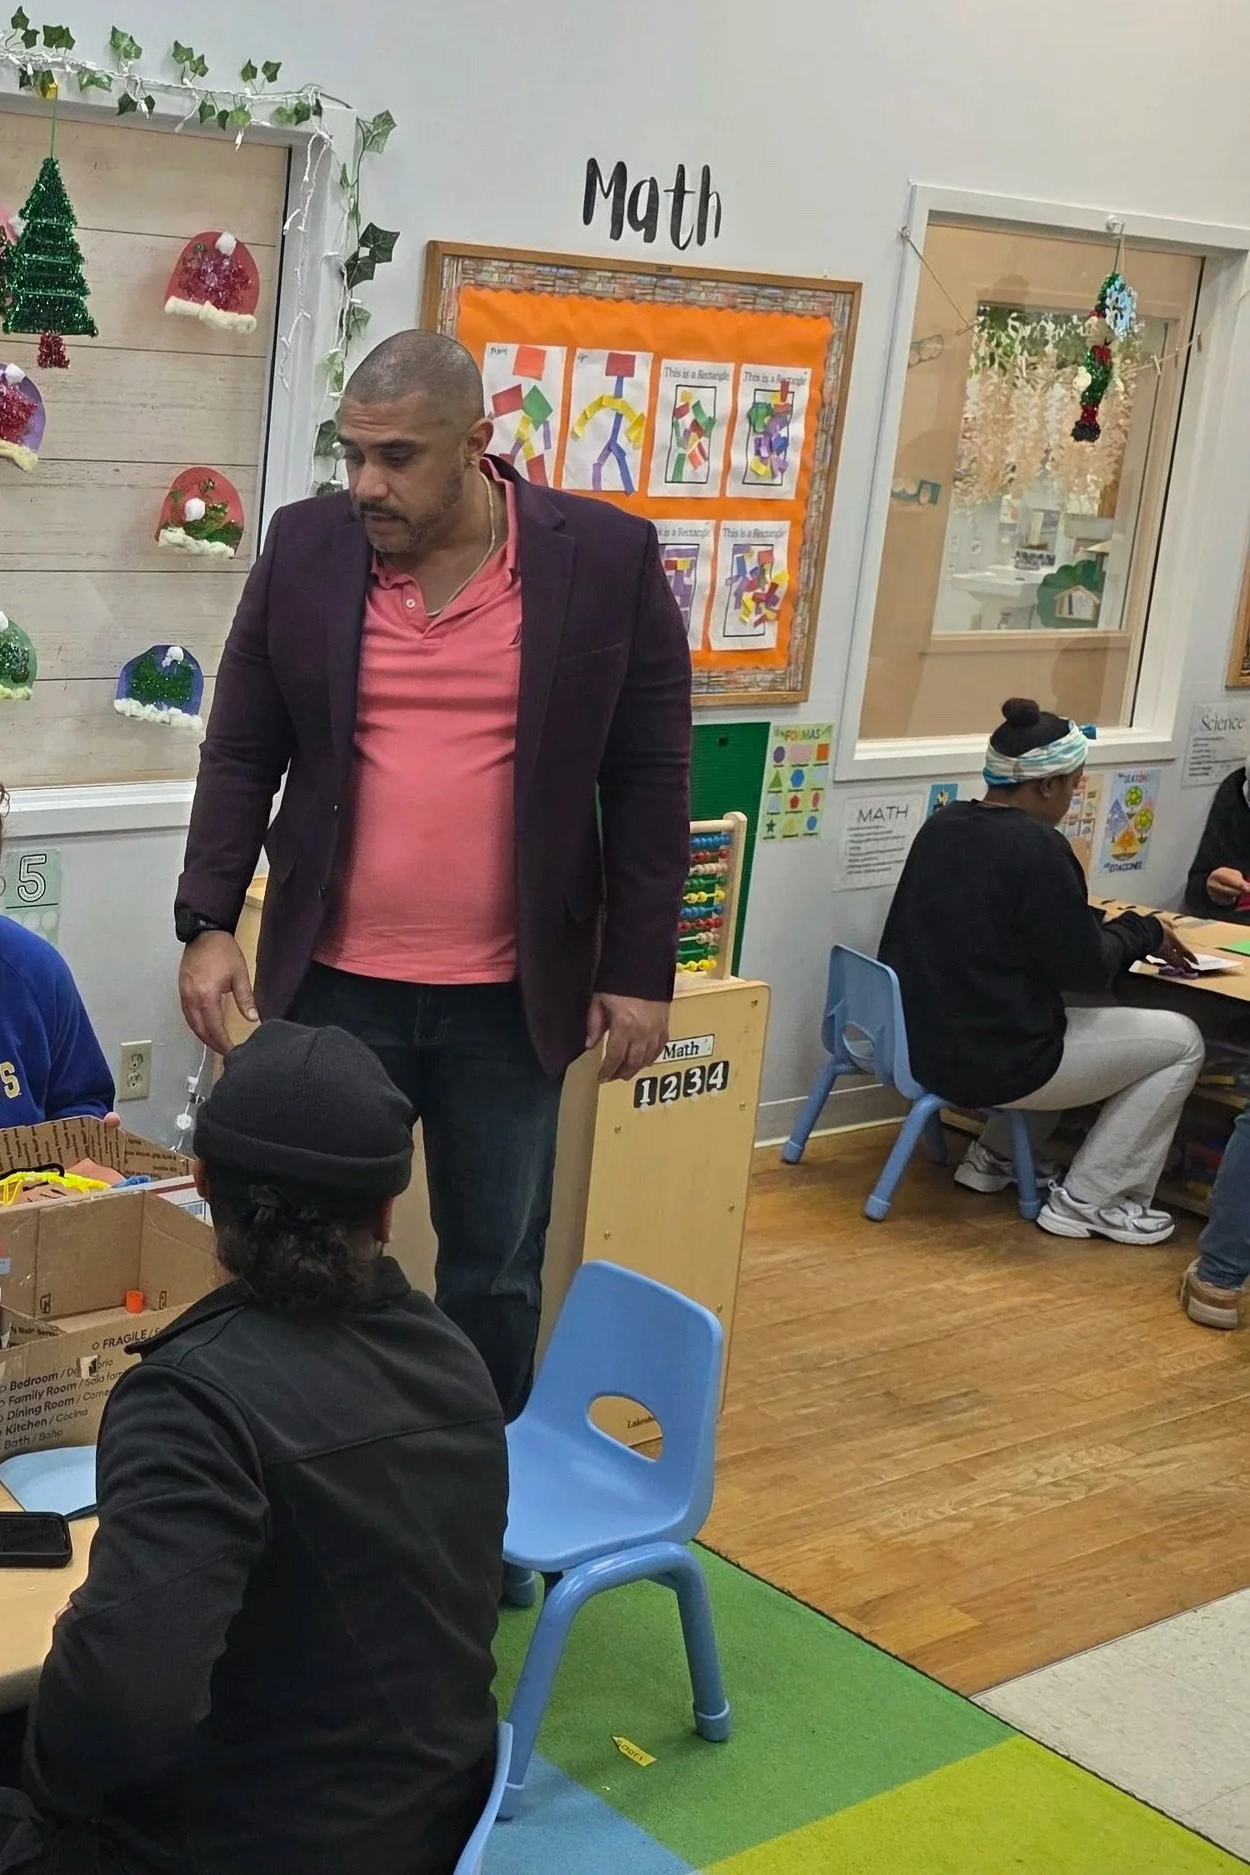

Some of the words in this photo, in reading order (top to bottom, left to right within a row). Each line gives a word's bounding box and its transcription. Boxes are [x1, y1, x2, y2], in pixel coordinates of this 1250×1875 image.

[583, 157, 722, 250] Math
[664, 367, 681, 379] This
[682, 368, 689, 379] is
[691, 371, 696, 379] a
[744, 371, 760, 382] This
[762, 373, 769, 383] is
[723, 527, 739, 538] This
[1199, 715, 1246, 732] Science
[857, 804, 909, 823] MATH
[17, 853, 48, 902] 5
[663, 1041, 700, 1060] Math
[102, 1328, 147, 1349] FRAGILE
[9, 1371, 59, 1391] Bedroom
[8, 1388, 45, 1406] Family
[46, 1381, 77, 1397] Room
[7, 1404, 42, 1421] Dining
[44, 1396, 75, 1412] Room
[5, 1417, 48, 1436] Kitchen
[56, 1407, 88, 1423] Cocina
[4, 1437, 30, 1450] Bath
